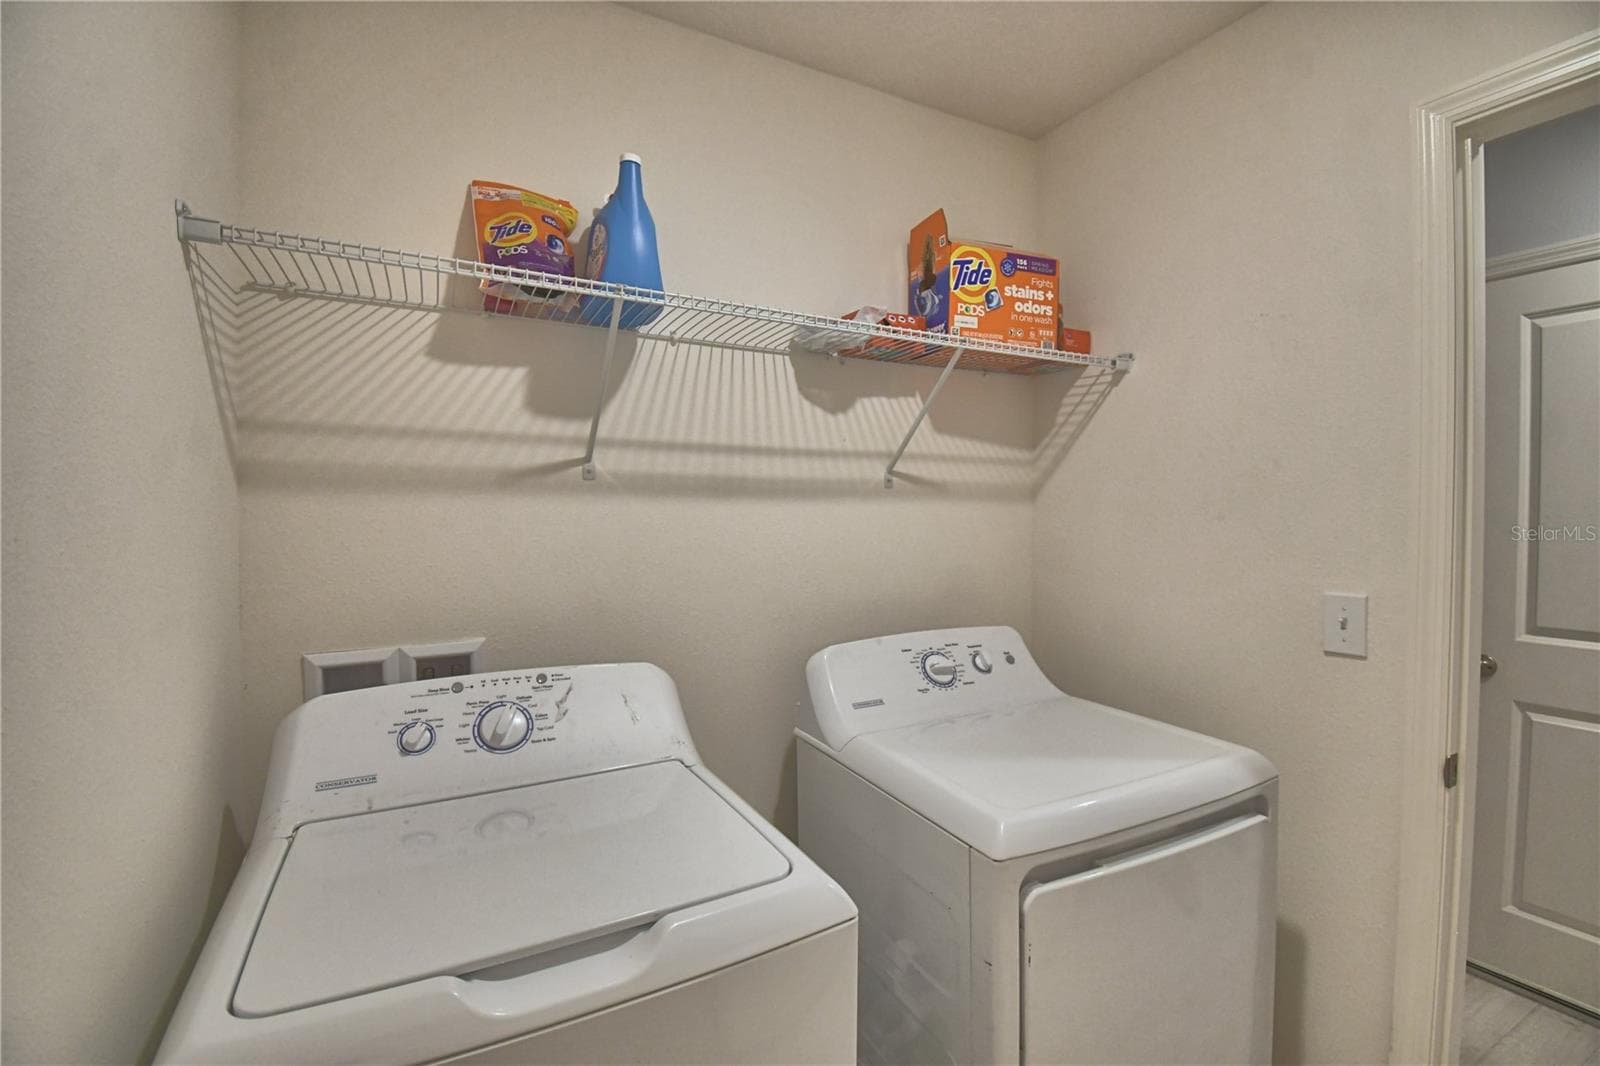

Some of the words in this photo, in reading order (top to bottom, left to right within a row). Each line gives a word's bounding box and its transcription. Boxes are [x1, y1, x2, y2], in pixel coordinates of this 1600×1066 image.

[489, 219, 533, 244] Tide
[952, 258, 993, 291] Tide
[1031, 278, 1054, 289] Fights
[1004, 284, 1045, 301] stains
[1045, 290, 1054, 301] +
[957, 303, 985, 317] PODS
[1014, 300, 1053, 316] odors
[1011, 312, 1019, 321] in
[1019, 315, 1033, 323] one
[1033, 317, 1053, 325] wash
